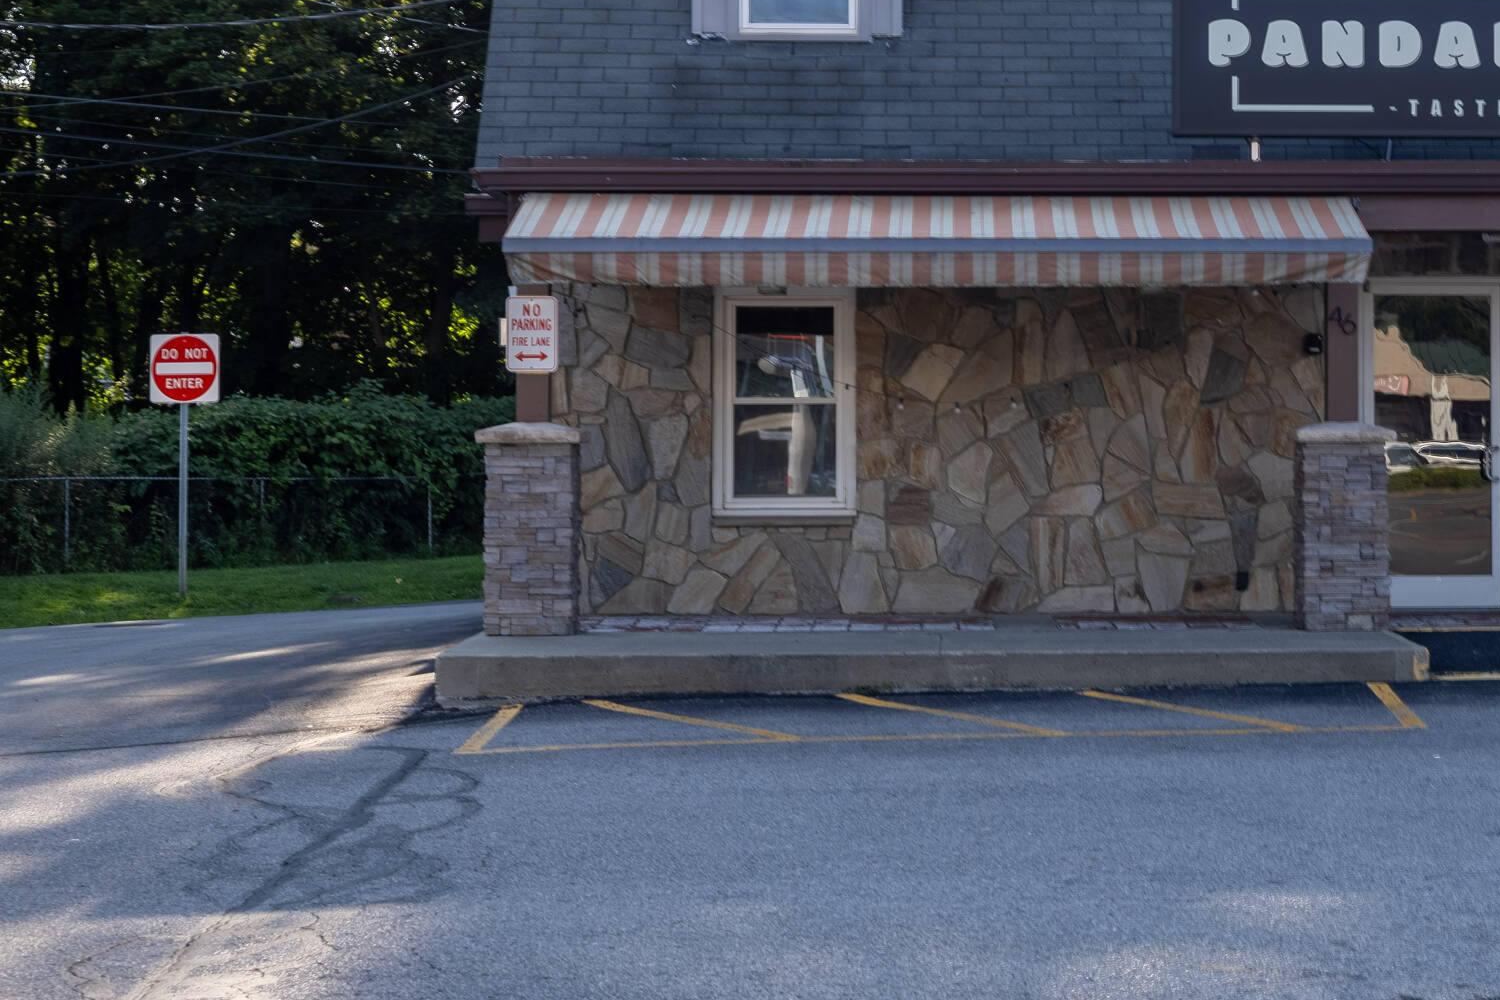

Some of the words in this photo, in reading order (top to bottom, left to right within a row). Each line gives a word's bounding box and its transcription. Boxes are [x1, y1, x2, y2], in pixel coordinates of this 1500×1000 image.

[522, 304, 541, 316] NO
[511, 318, 552, 331] PARKING
[512, 336, 529, 347] FIRE
[530, 336, 551, 347] LANE
[161, 348, 179, 360] DO
[184, 347, 209, 360] NOT
[165, 377, 204, 390] ENTER
